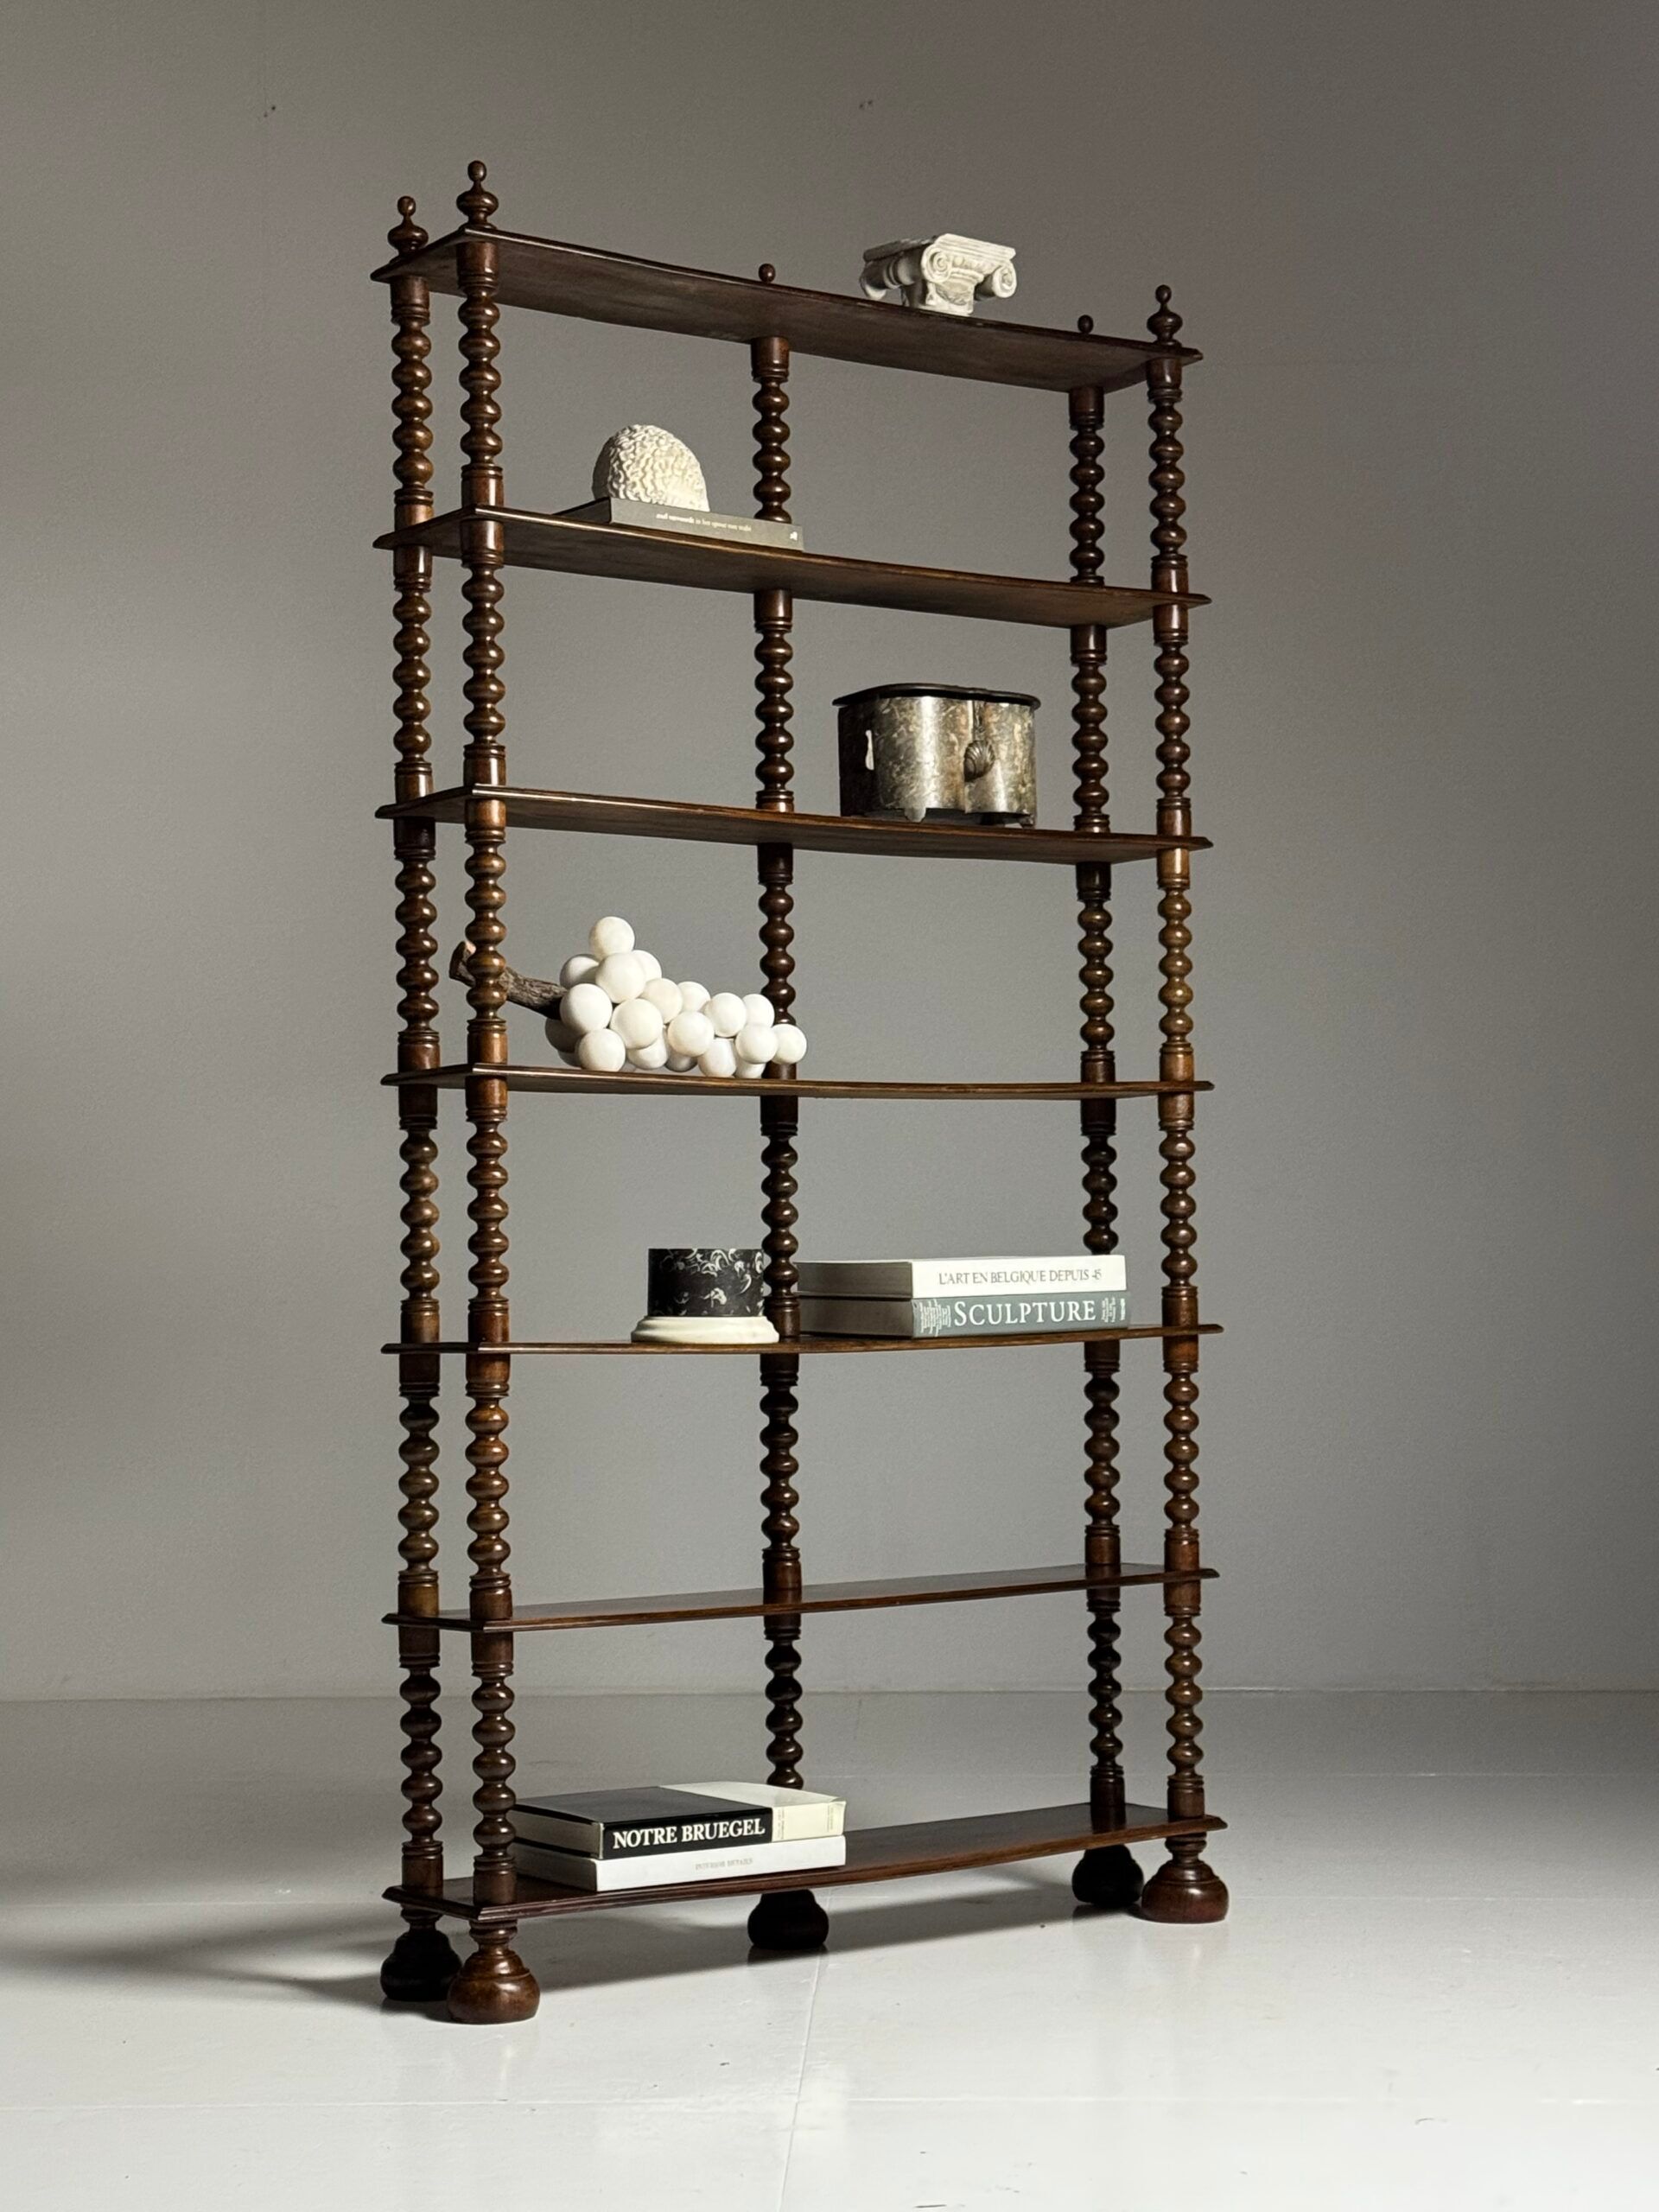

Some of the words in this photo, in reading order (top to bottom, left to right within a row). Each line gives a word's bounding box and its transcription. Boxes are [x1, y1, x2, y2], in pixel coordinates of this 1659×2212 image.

[938, 1272, 970, 1285] L'ART
[972, 1272, 988, 1284] EN
[990, 1269, 1047, 1286] BELGIQUE
[1049, 1268, 1090, 1281] DEPUIS
[612, 1826, 677, 1850] NOTRE
[681, 1817, 766, 1843] BRUEGEL
